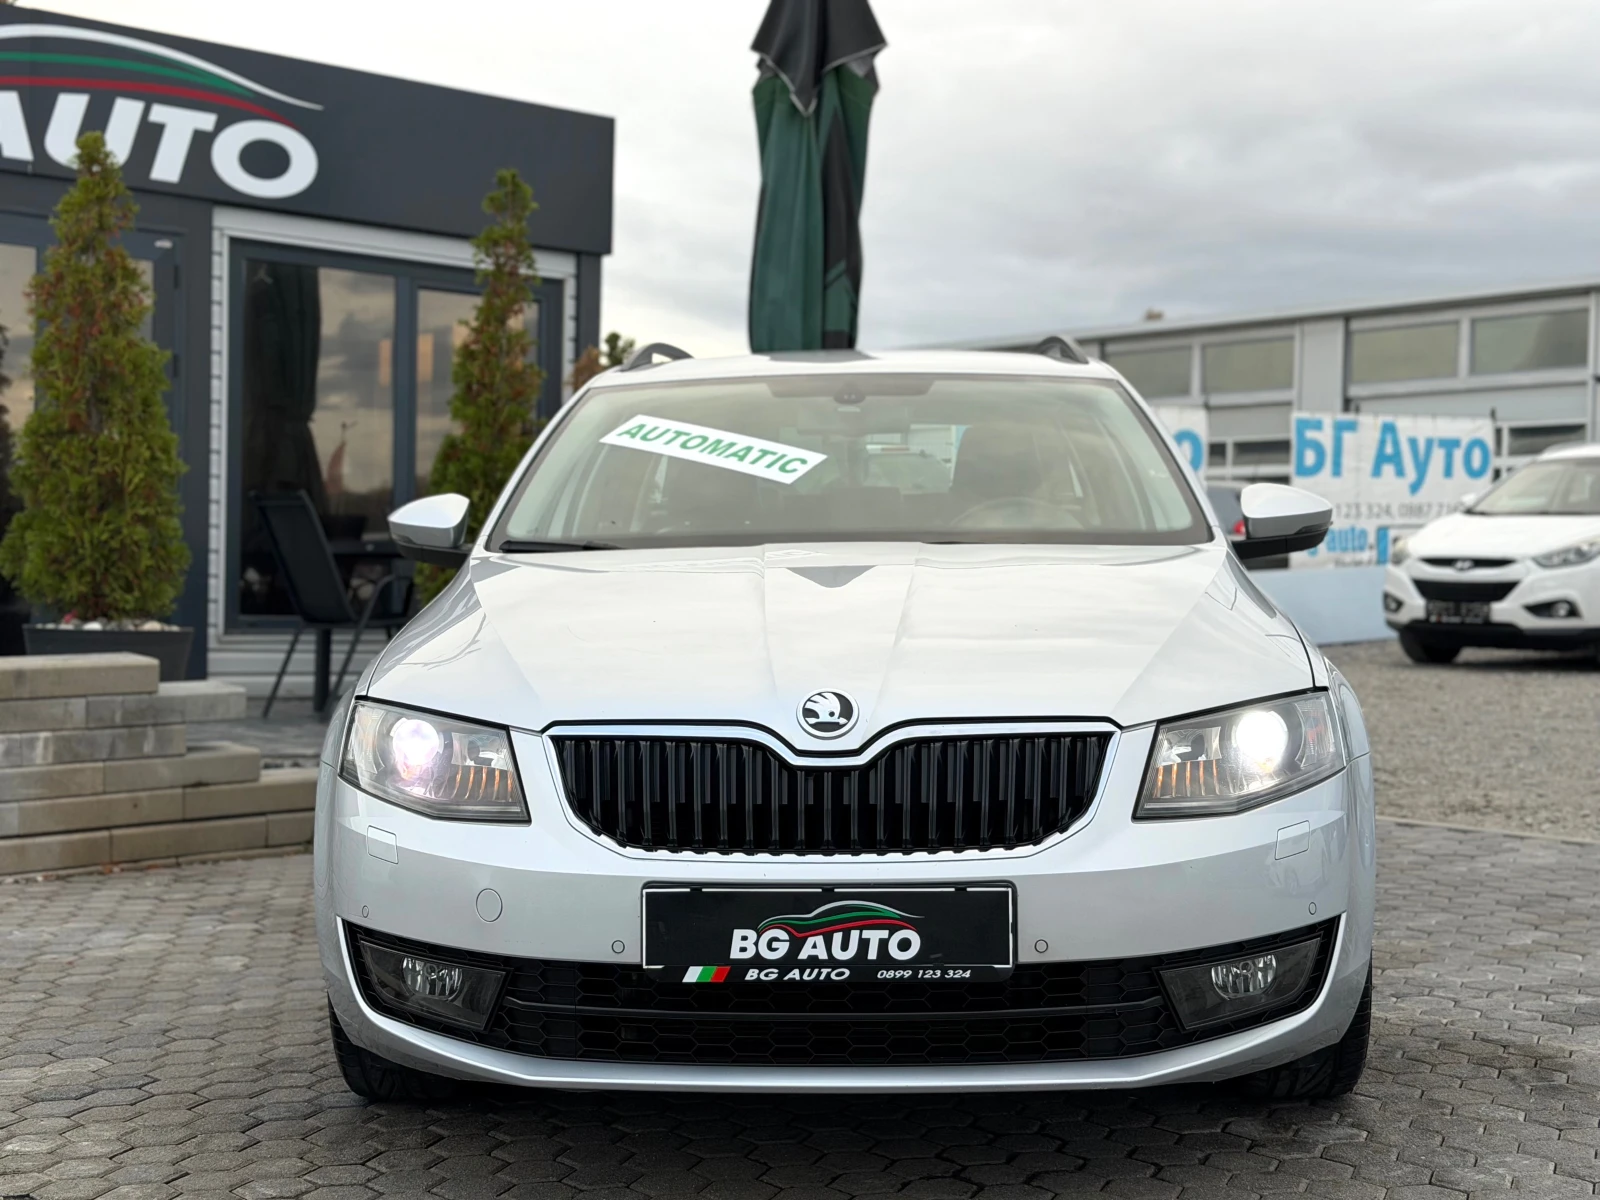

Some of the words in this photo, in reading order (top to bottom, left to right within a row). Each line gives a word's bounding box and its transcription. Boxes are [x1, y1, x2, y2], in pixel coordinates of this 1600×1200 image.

[615, 422, 808, 475] AUTOMATIC
[1295, 416, 1358, 478] БГ
[1370, 421, 1492, 495] Ауто
[729, 928, 790, 960] BG
[797, 928, 921, 960] AUTO
[744, 968, 779, 981] BG
[783, 968, 851, 981] AUTO
[876, 969, 912, 980] 0899
[916, 969, 942, 979] 123
[944, 969, 971, 979] 324
